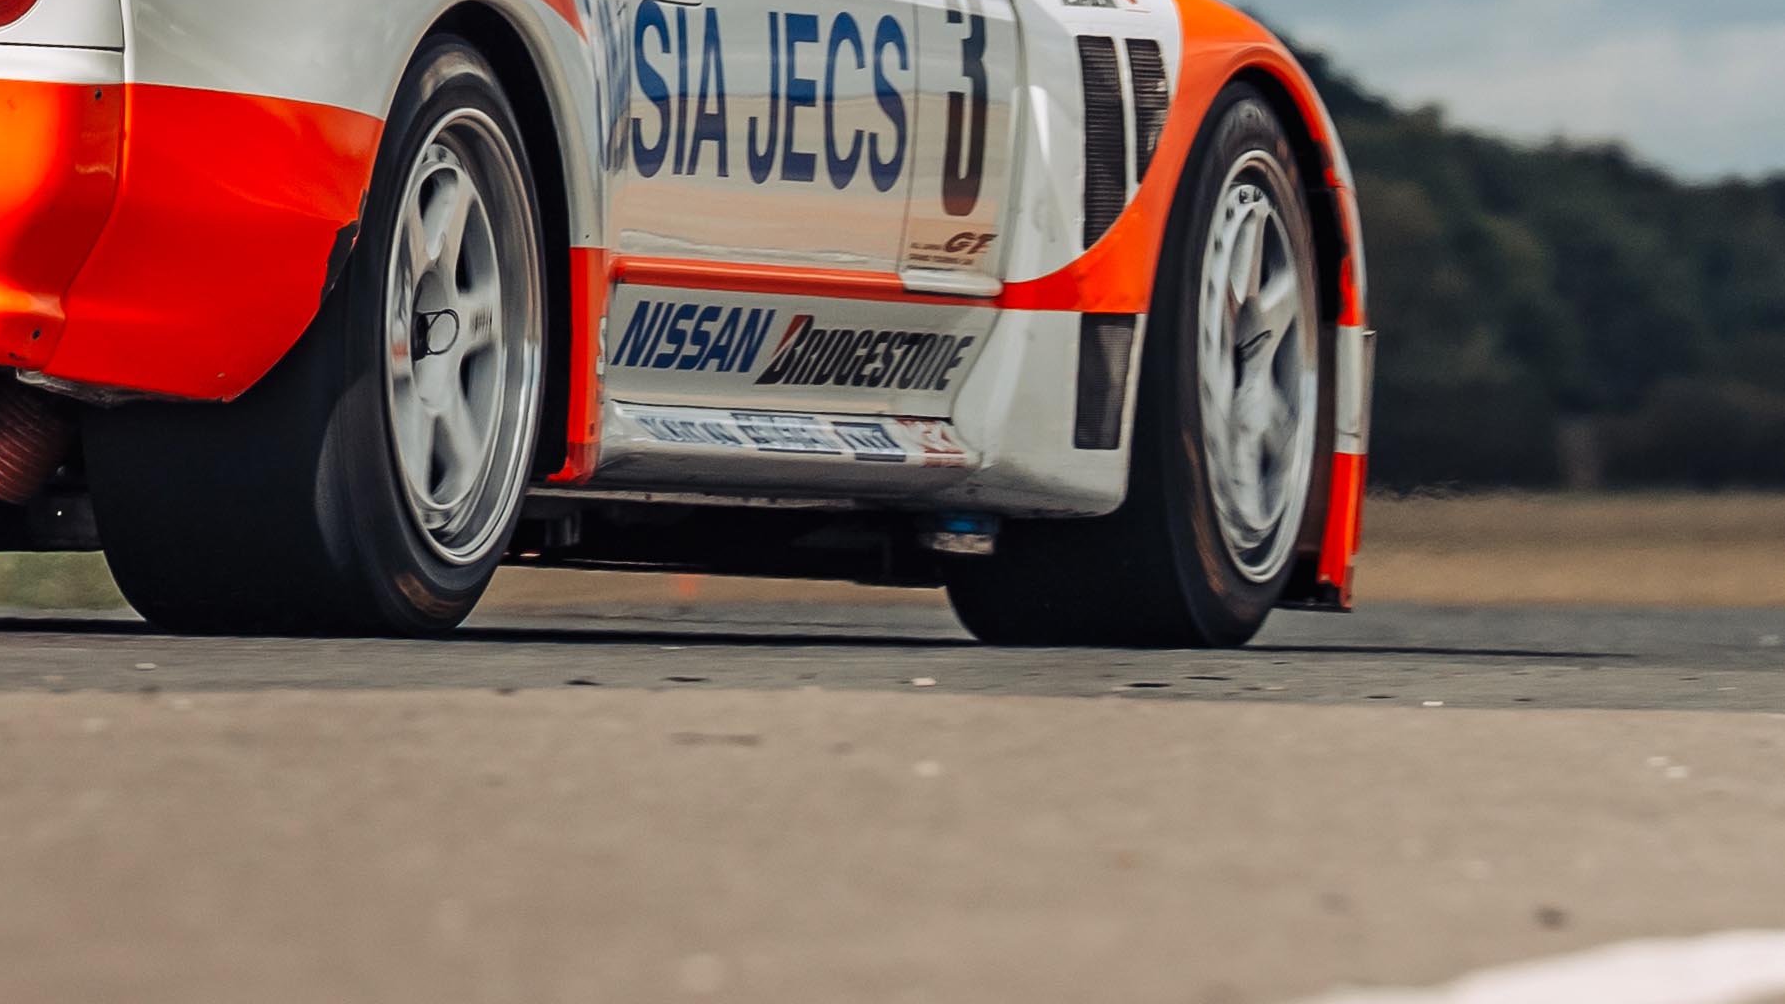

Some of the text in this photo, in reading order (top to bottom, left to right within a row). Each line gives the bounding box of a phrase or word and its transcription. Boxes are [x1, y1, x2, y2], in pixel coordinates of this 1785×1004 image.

[747, 11, 910, 192] JECS
[610, 300, 975, 391] NISSAN BRIDGESTONE
